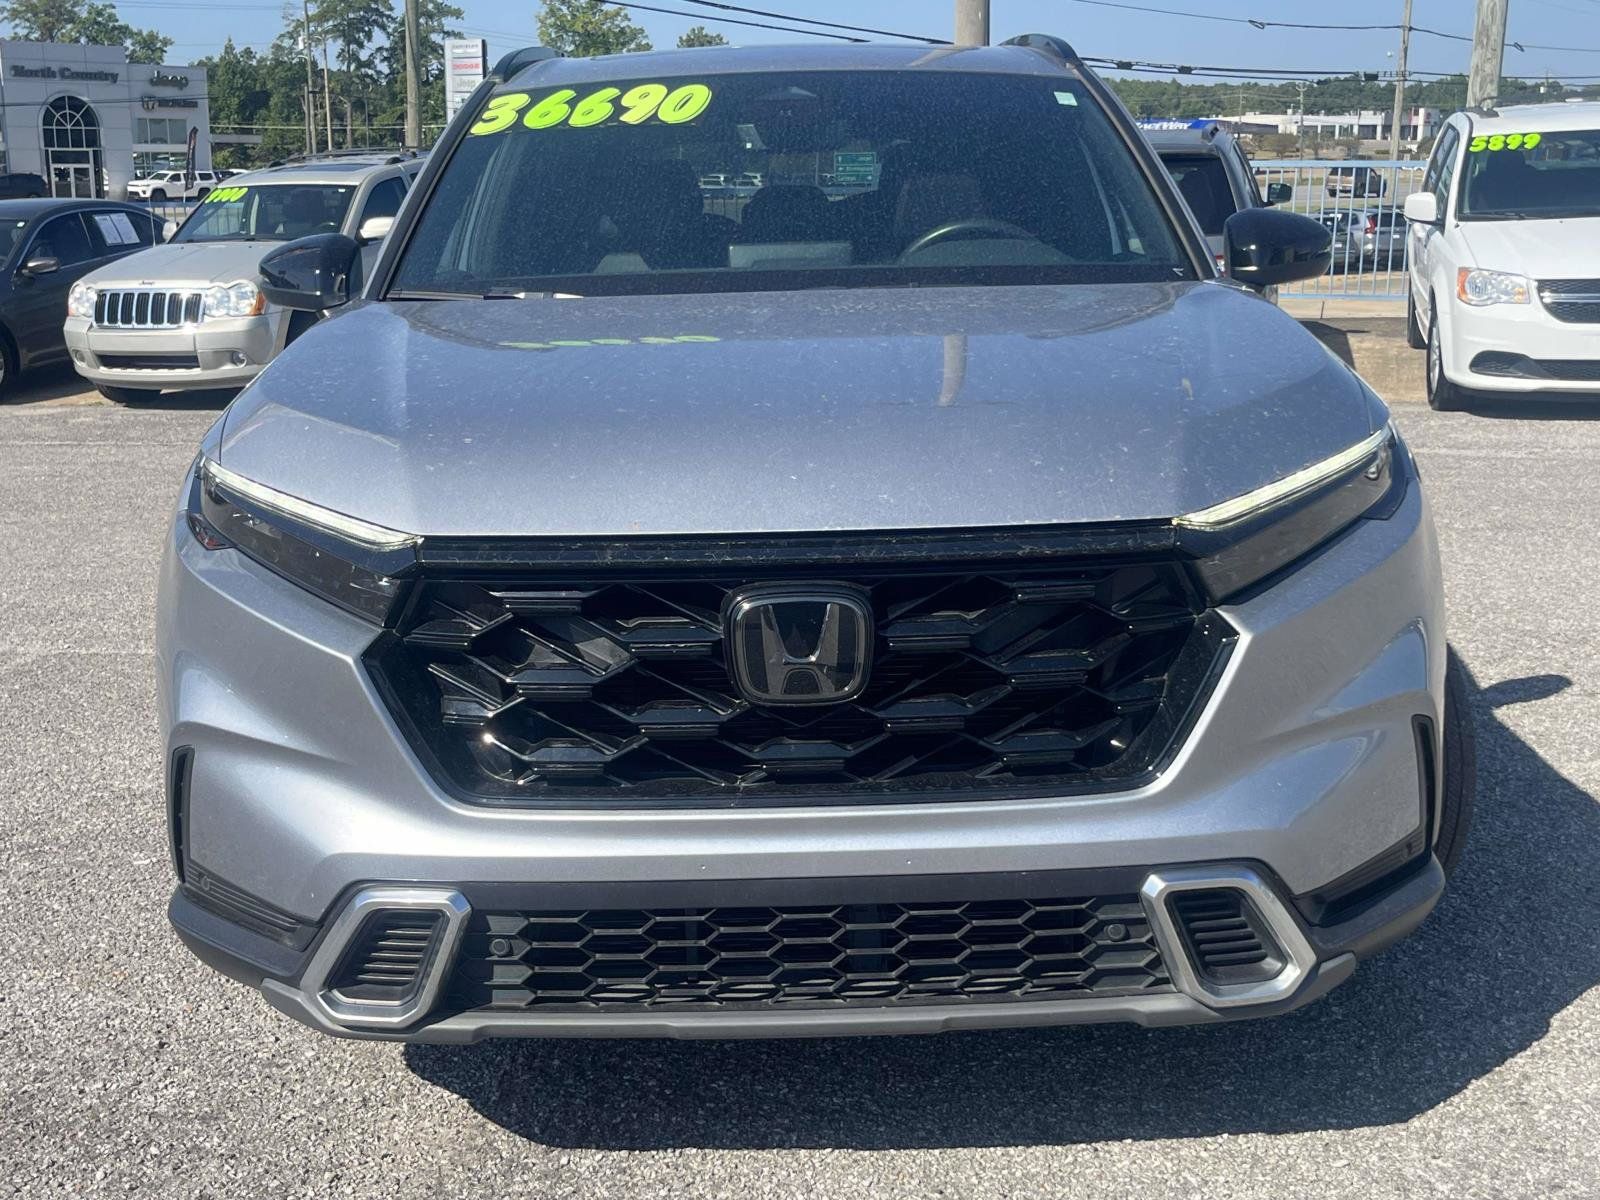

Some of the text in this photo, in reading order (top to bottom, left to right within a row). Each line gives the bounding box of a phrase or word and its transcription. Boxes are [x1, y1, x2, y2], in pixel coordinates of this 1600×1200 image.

[10, 64, 119, 84] North Country
[149, 70, 189, 90] Jeep
[470, 84, 712, 136] 36690
[1469, 133, 1541, 152] 5899
